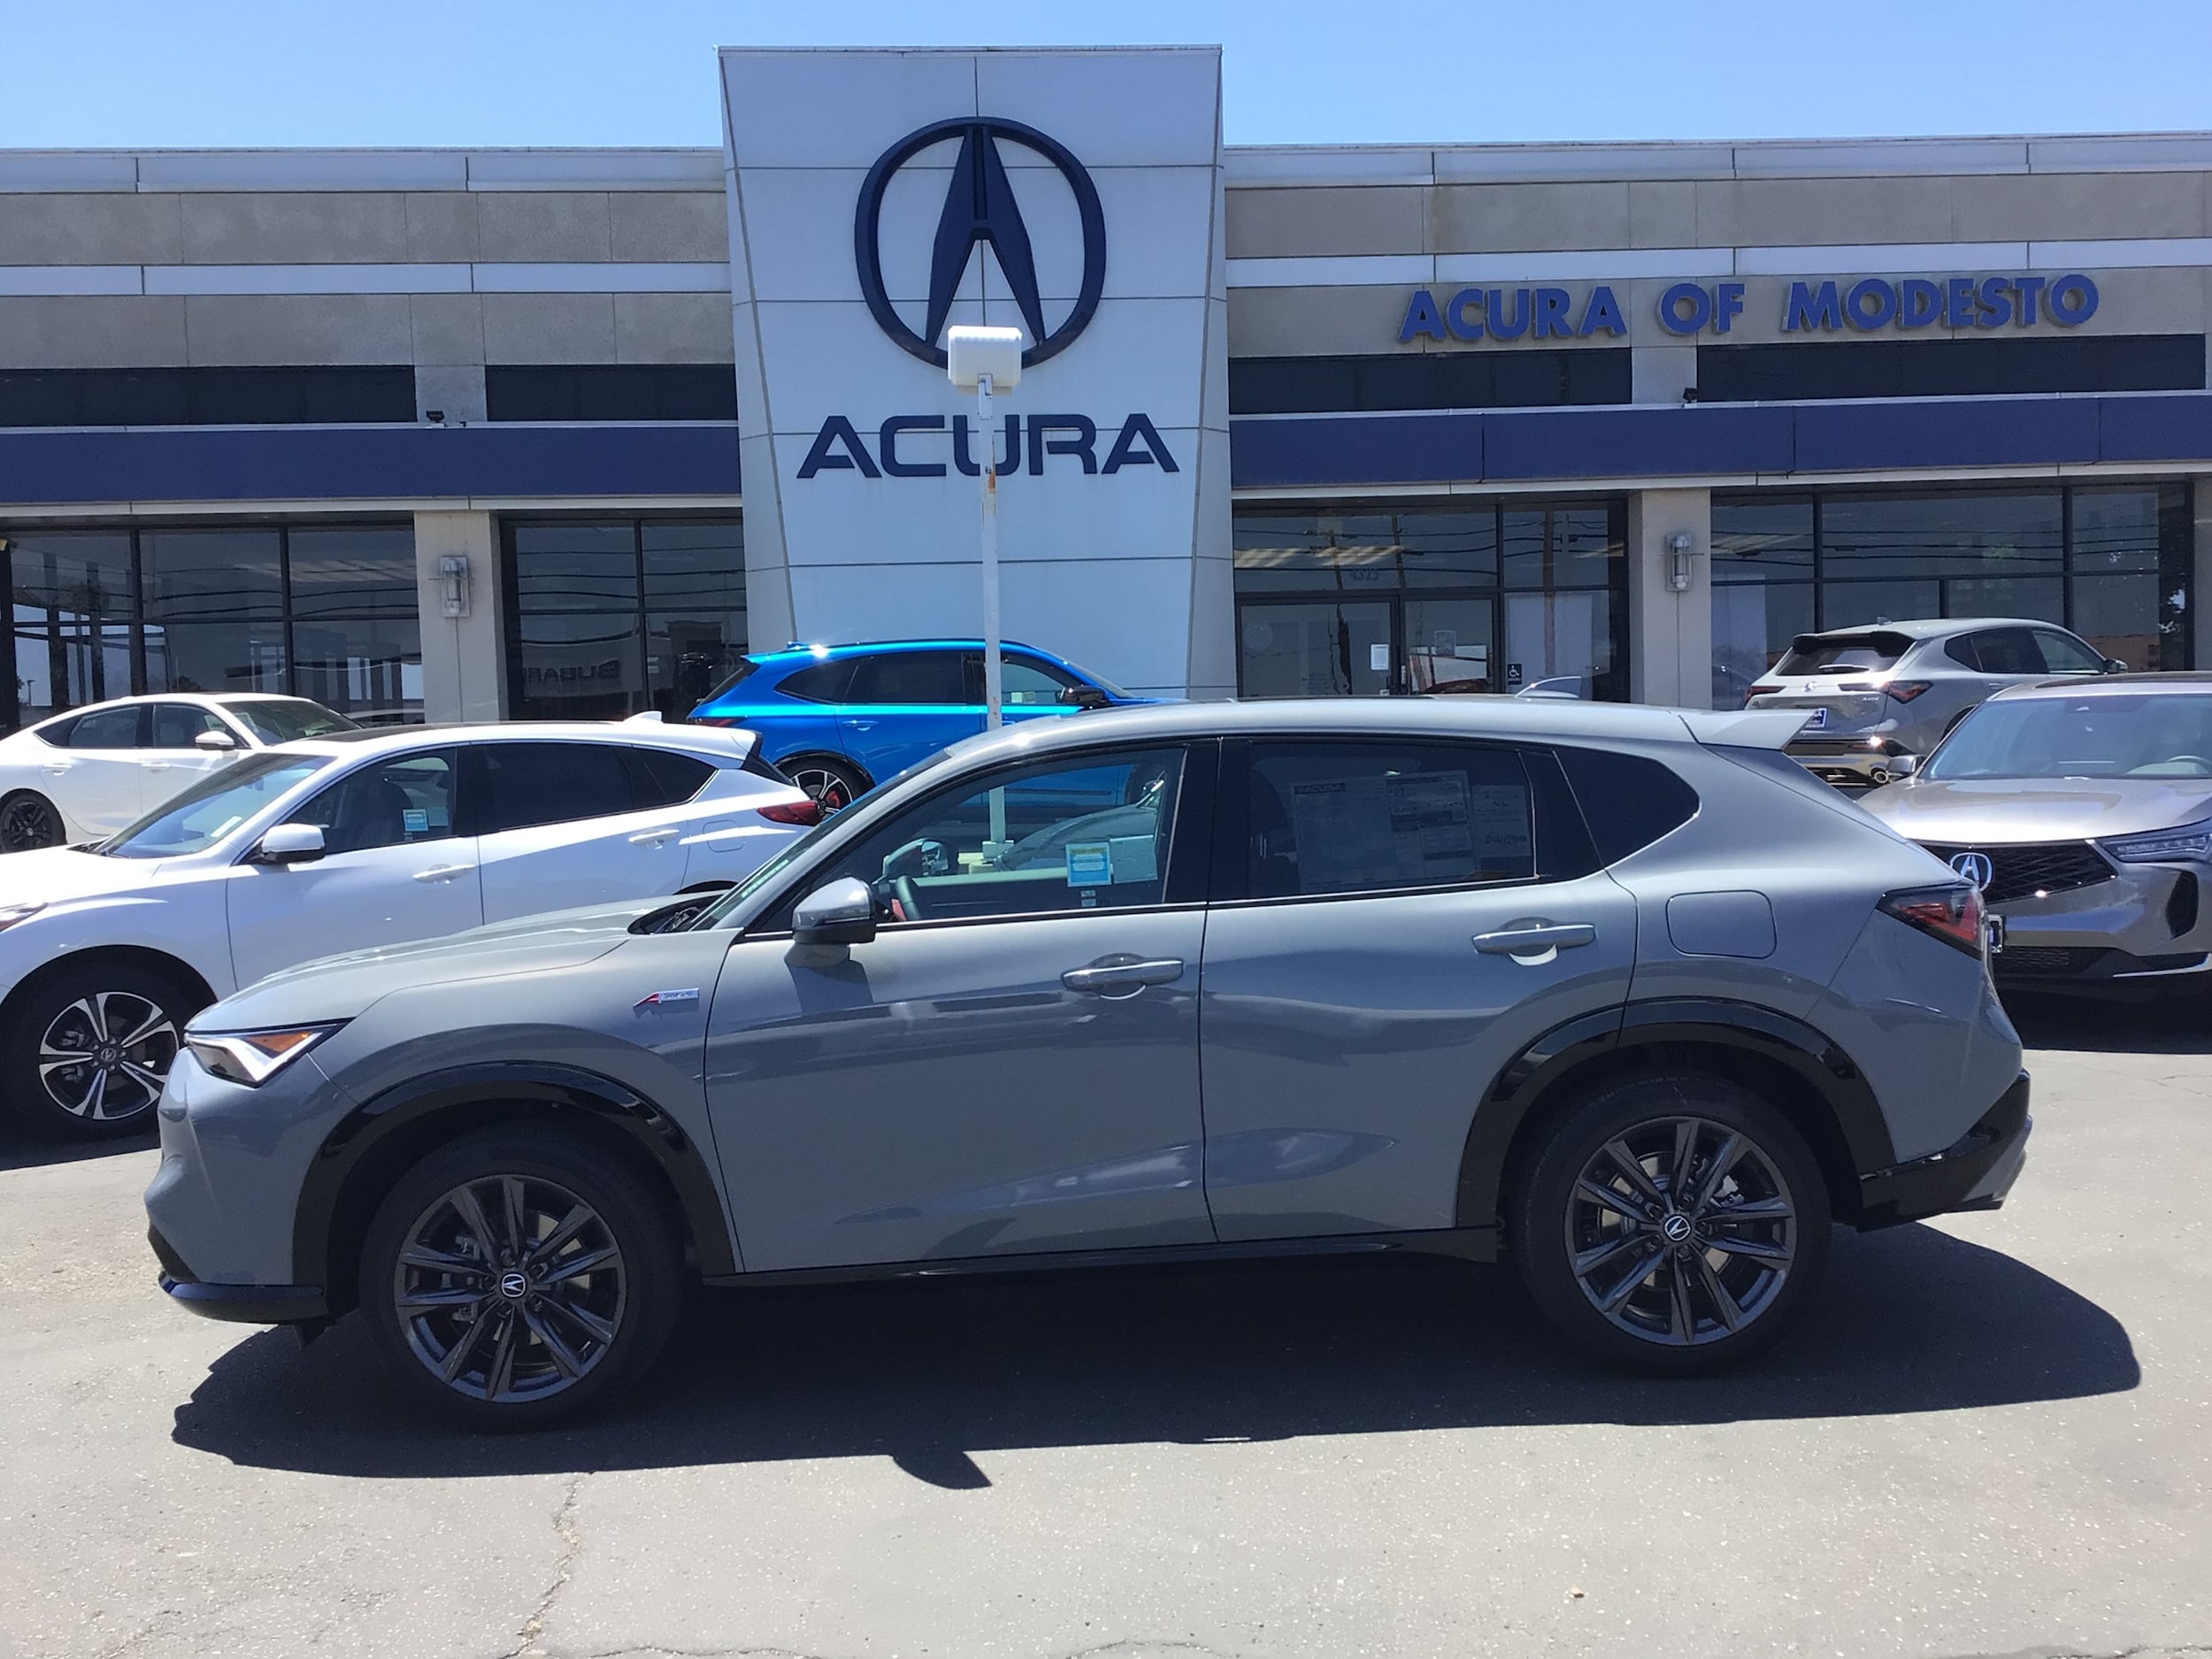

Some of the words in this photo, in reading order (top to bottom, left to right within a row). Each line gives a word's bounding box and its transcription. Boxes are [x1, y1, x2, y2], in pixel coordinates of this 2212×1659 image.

[1398, 285, 1628, 342] ACURA
[1657, 282, 1746, 337] OF
[1785, 273, 2100, 333] MODESTO
[796, 412, 1180, 479] ACURA
